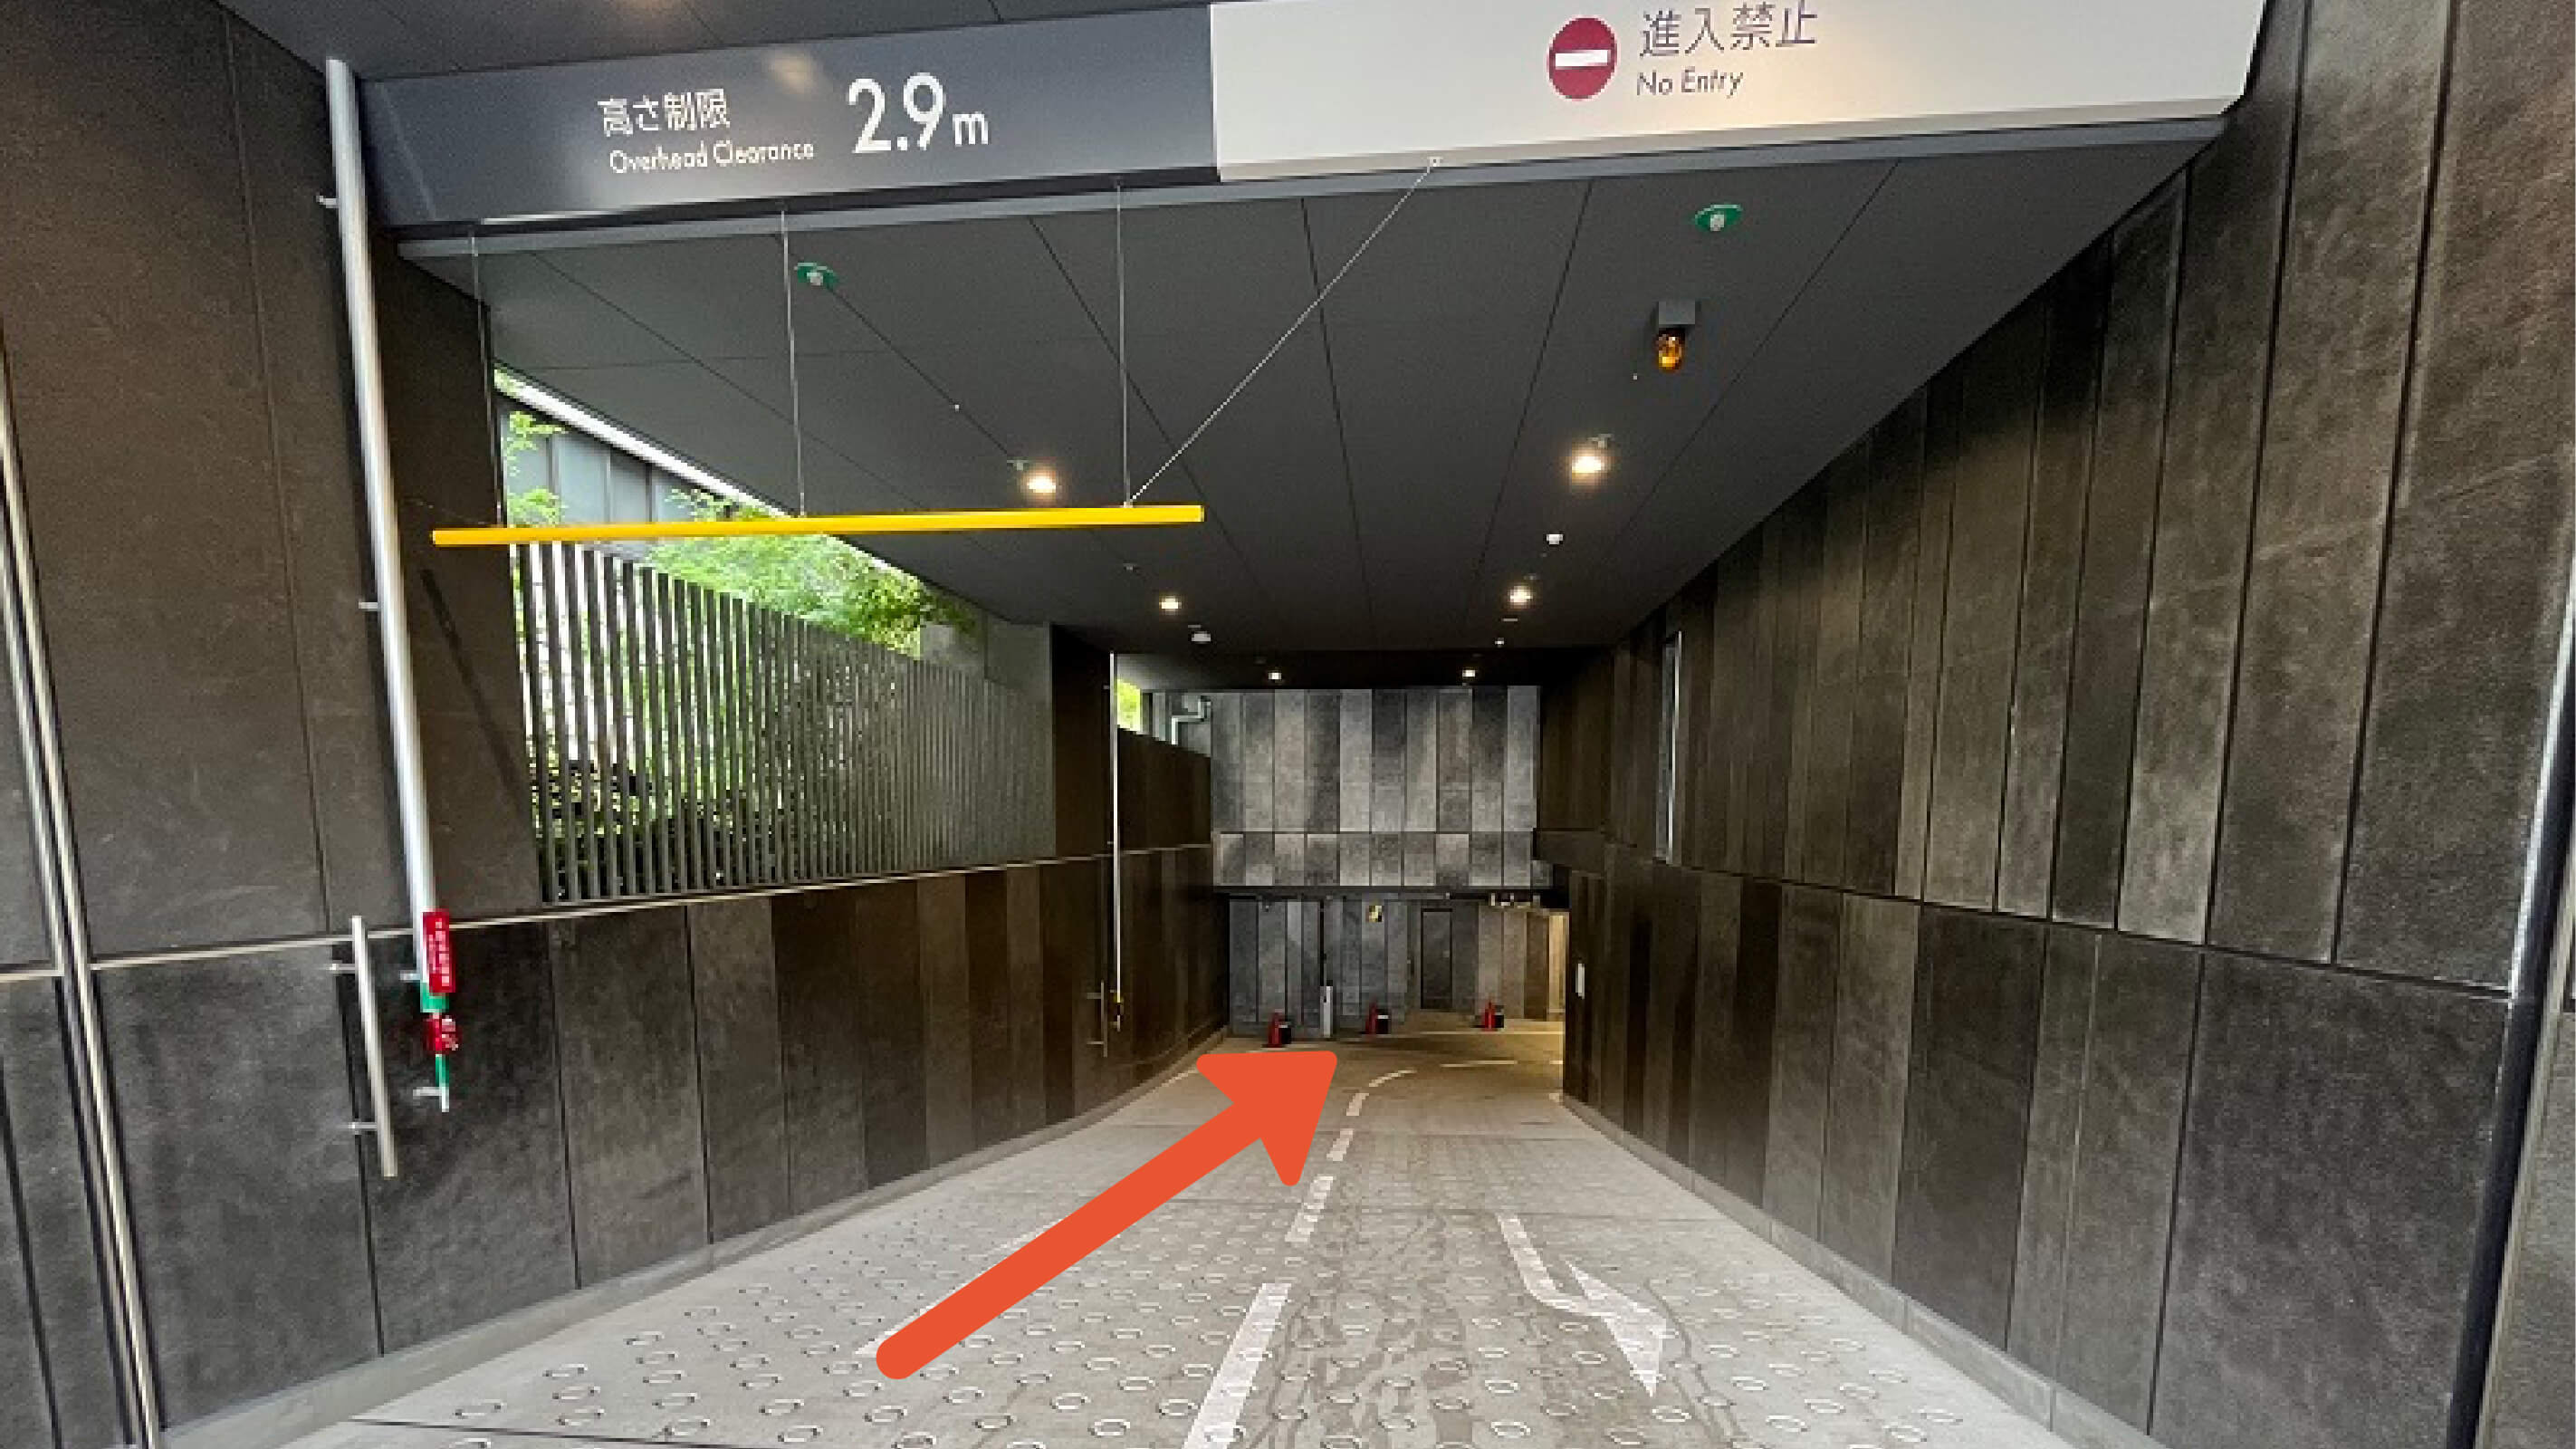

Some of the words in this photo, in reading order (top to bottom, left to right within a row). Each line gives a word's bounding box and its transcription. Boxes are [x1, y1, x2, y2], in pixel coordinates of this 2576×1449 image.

[1639, 0, 1818, 57] 進入禁止
[1635, 69, 1674, 96] No
[1680, 66, 1745, 99] Entry
[598, 88, 732, 138] 高さ制限
[609, 140, 708, 174] Overhead
[712, 139, 815, 167] Clearance
